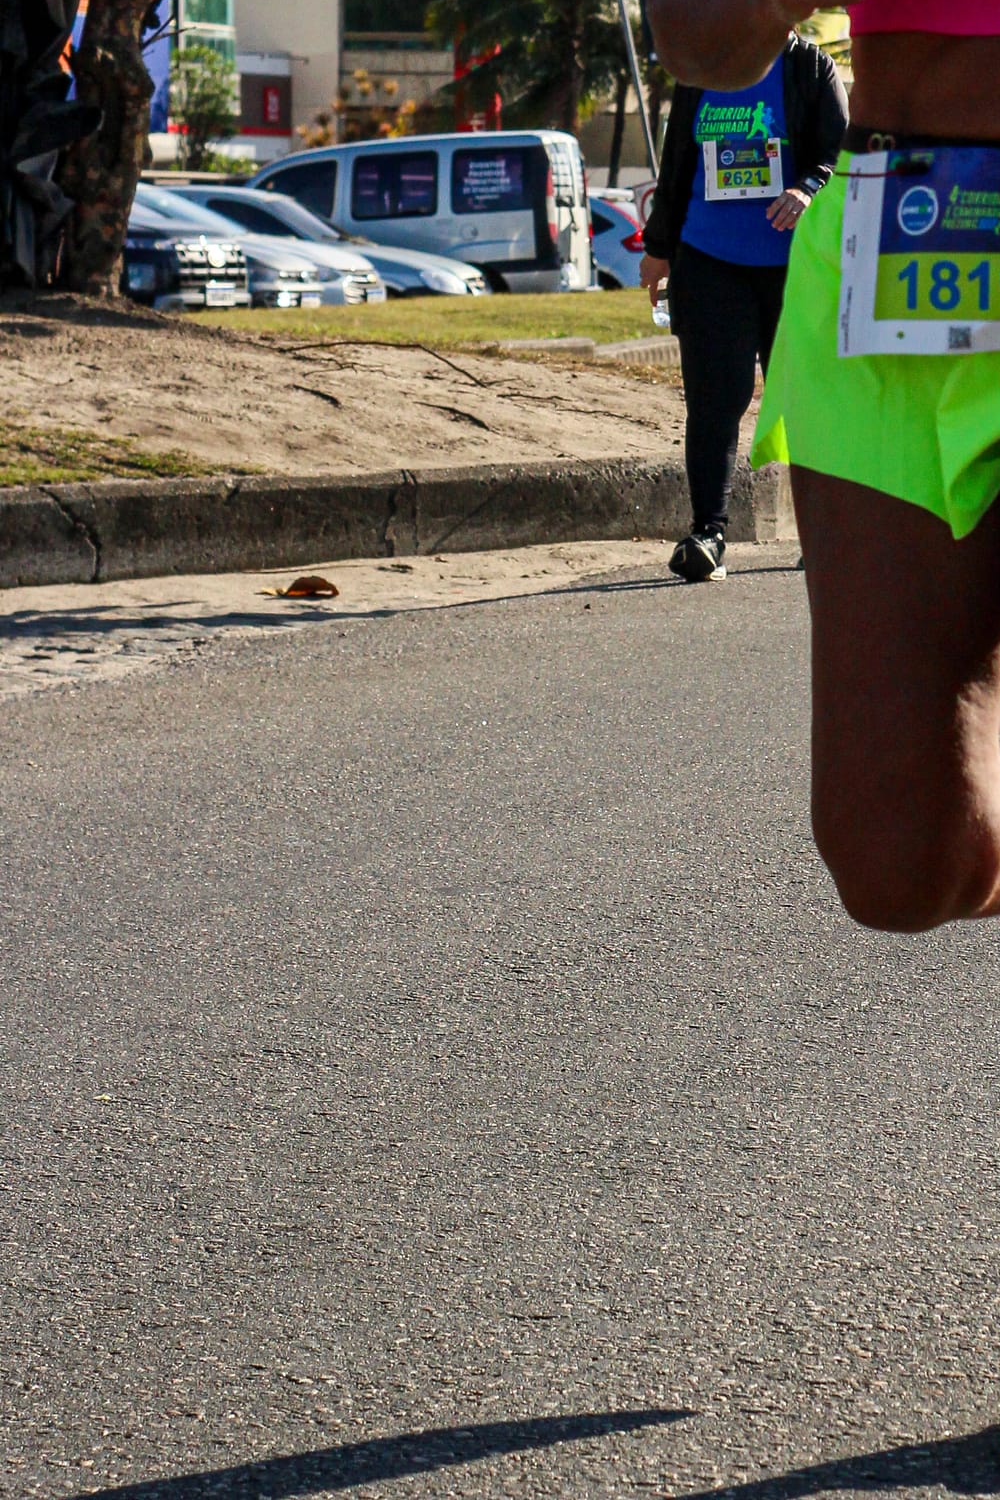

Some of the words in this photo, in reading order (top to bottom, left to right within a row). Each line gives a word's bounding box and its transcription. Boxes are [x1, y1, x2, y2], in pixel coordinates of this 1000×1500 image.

[708, 107, 752, 120] CORRIDA
[702, 122, 749, 133] CAMINHADA
[724, 170, 763, 186] 2621
